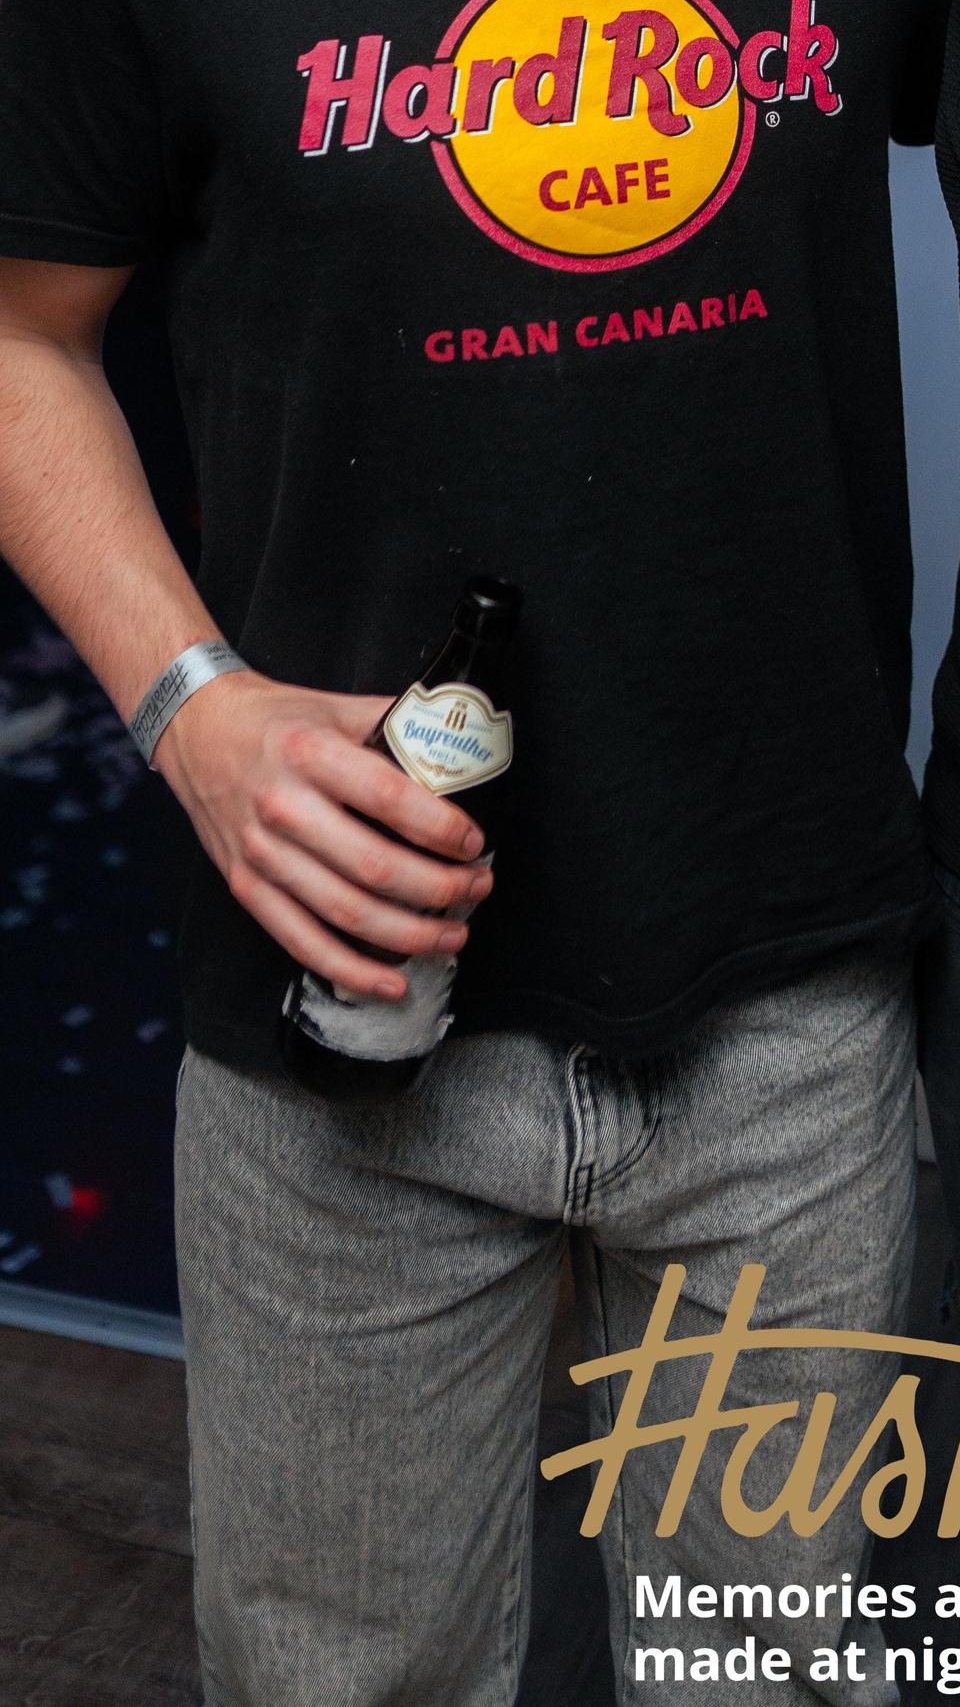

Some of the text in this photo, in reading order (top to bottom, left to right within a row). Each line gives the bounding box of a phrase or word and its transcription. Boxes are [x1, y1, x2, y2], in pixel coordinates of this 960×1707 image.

[296, 16, 589, 157] Hard
[539, 158, 671, 212] CAFE
[424, 289, 769, 363] GRAN CANARIA
[402, 718, 494, 764] Bayreuther
